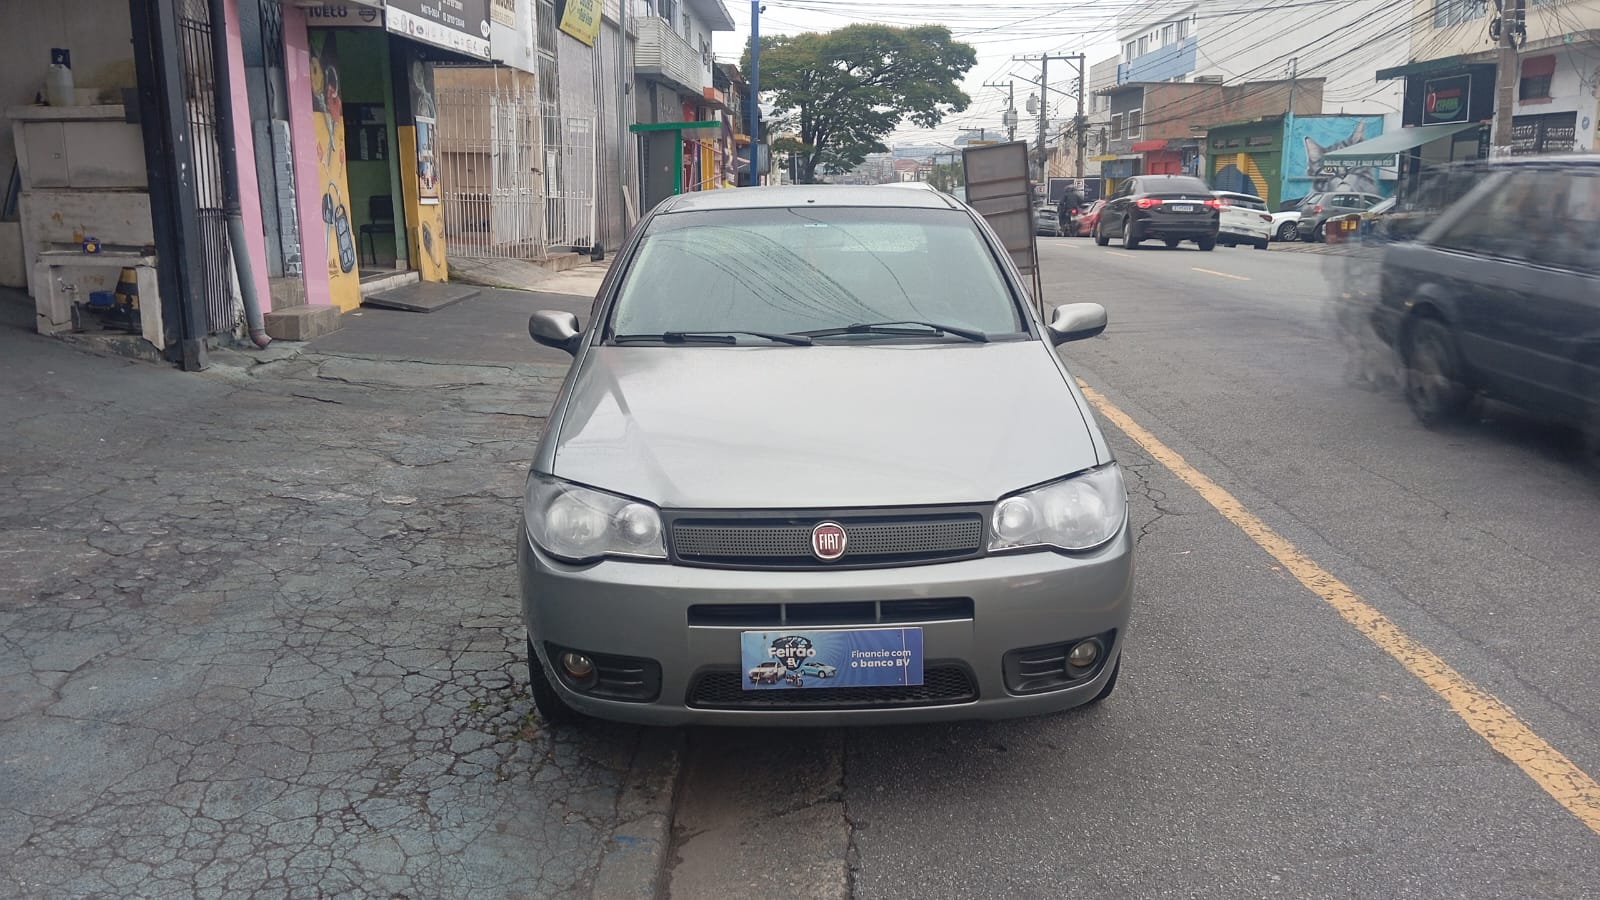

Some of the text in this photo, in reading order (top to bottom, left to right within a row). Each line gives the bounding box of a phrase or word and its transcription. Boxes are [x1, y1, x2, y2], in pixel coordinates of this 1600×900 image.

[309, 5, 347, 17] IVECO
[819, 533, 839, 550] FIAT
[767, 645, 817, 658] Feirão
[851, 649, 890, 658] Financie
[851, 658, 910, 668] o banco BV
